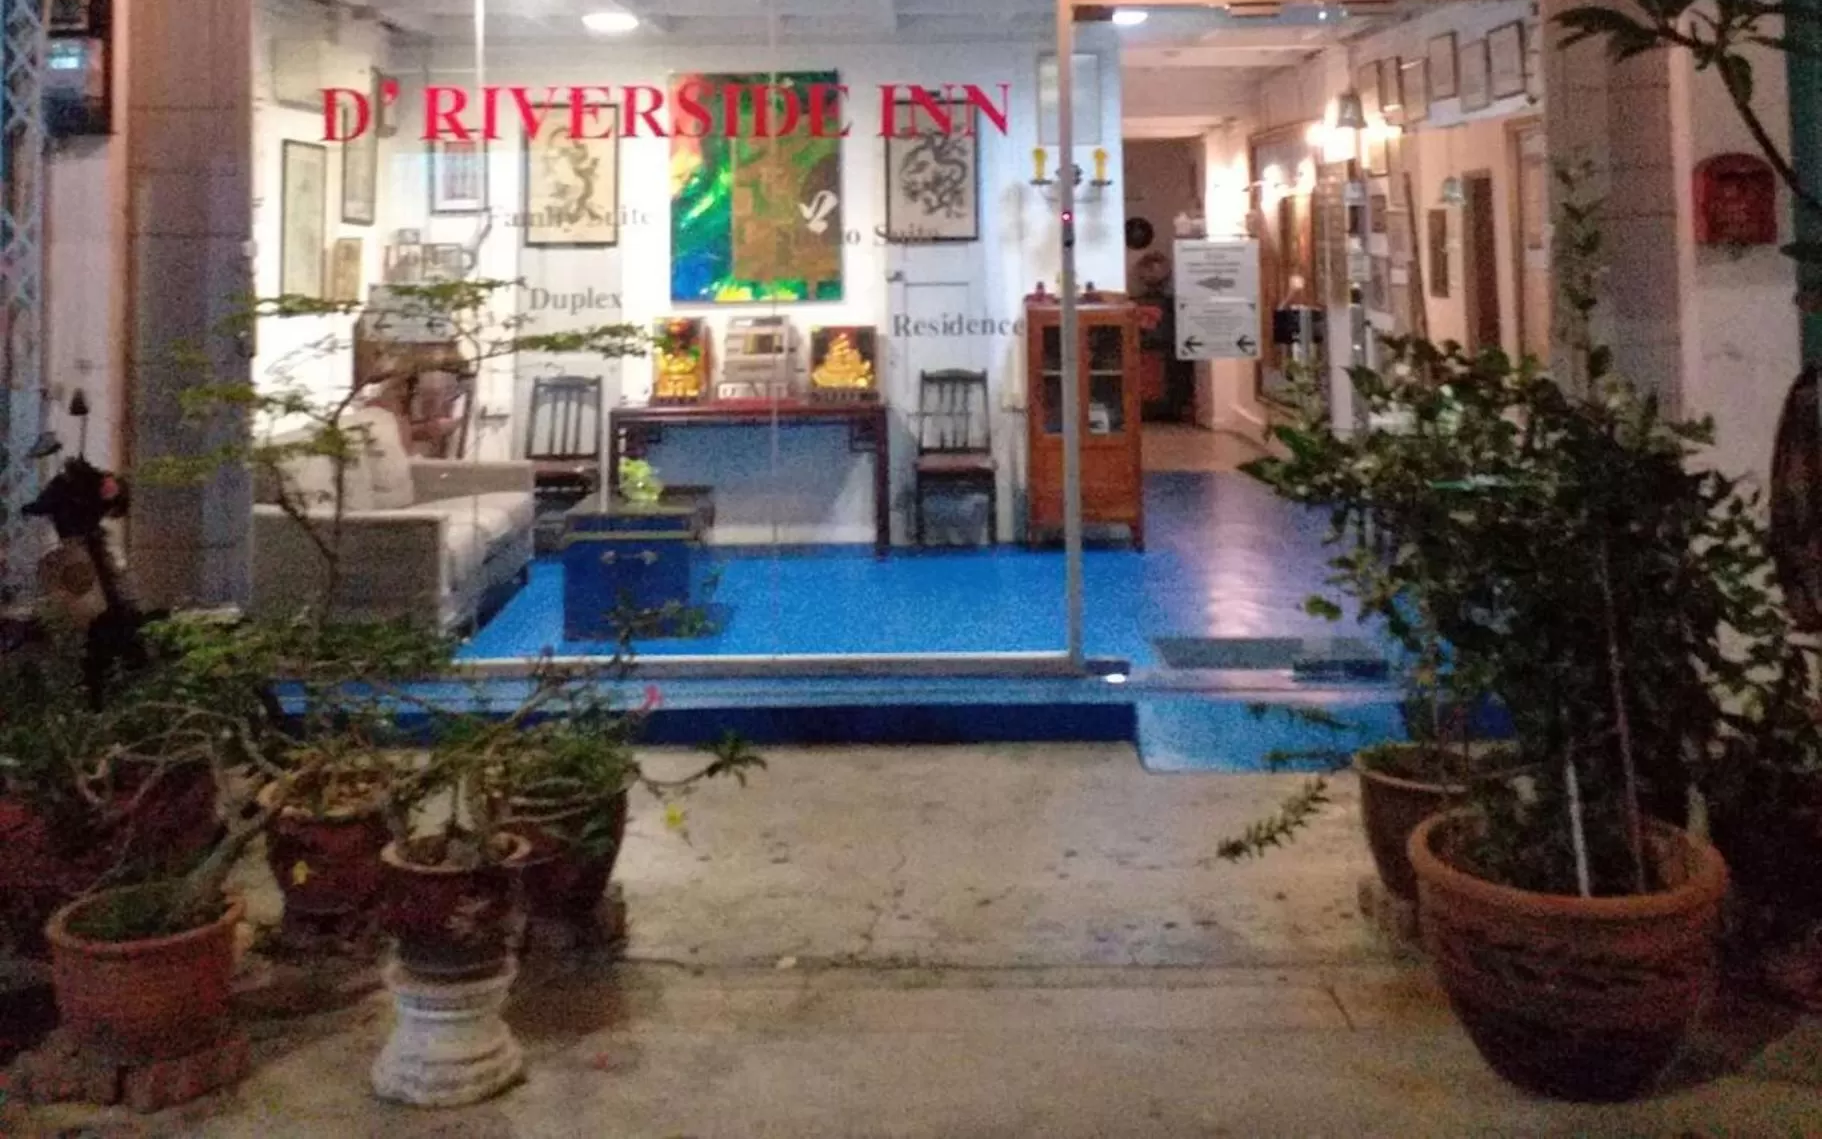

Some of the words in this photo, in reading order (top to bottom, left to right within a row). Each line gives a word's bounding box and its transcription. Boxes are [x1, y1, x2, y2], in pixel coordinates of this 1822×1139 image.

[419, 80, 853, 142] RIVERSIDE
[874, 82, 1013, 140] INN
[528, 286, 625, 318] Duplex
[893, 313, 1026, 338] Residence
